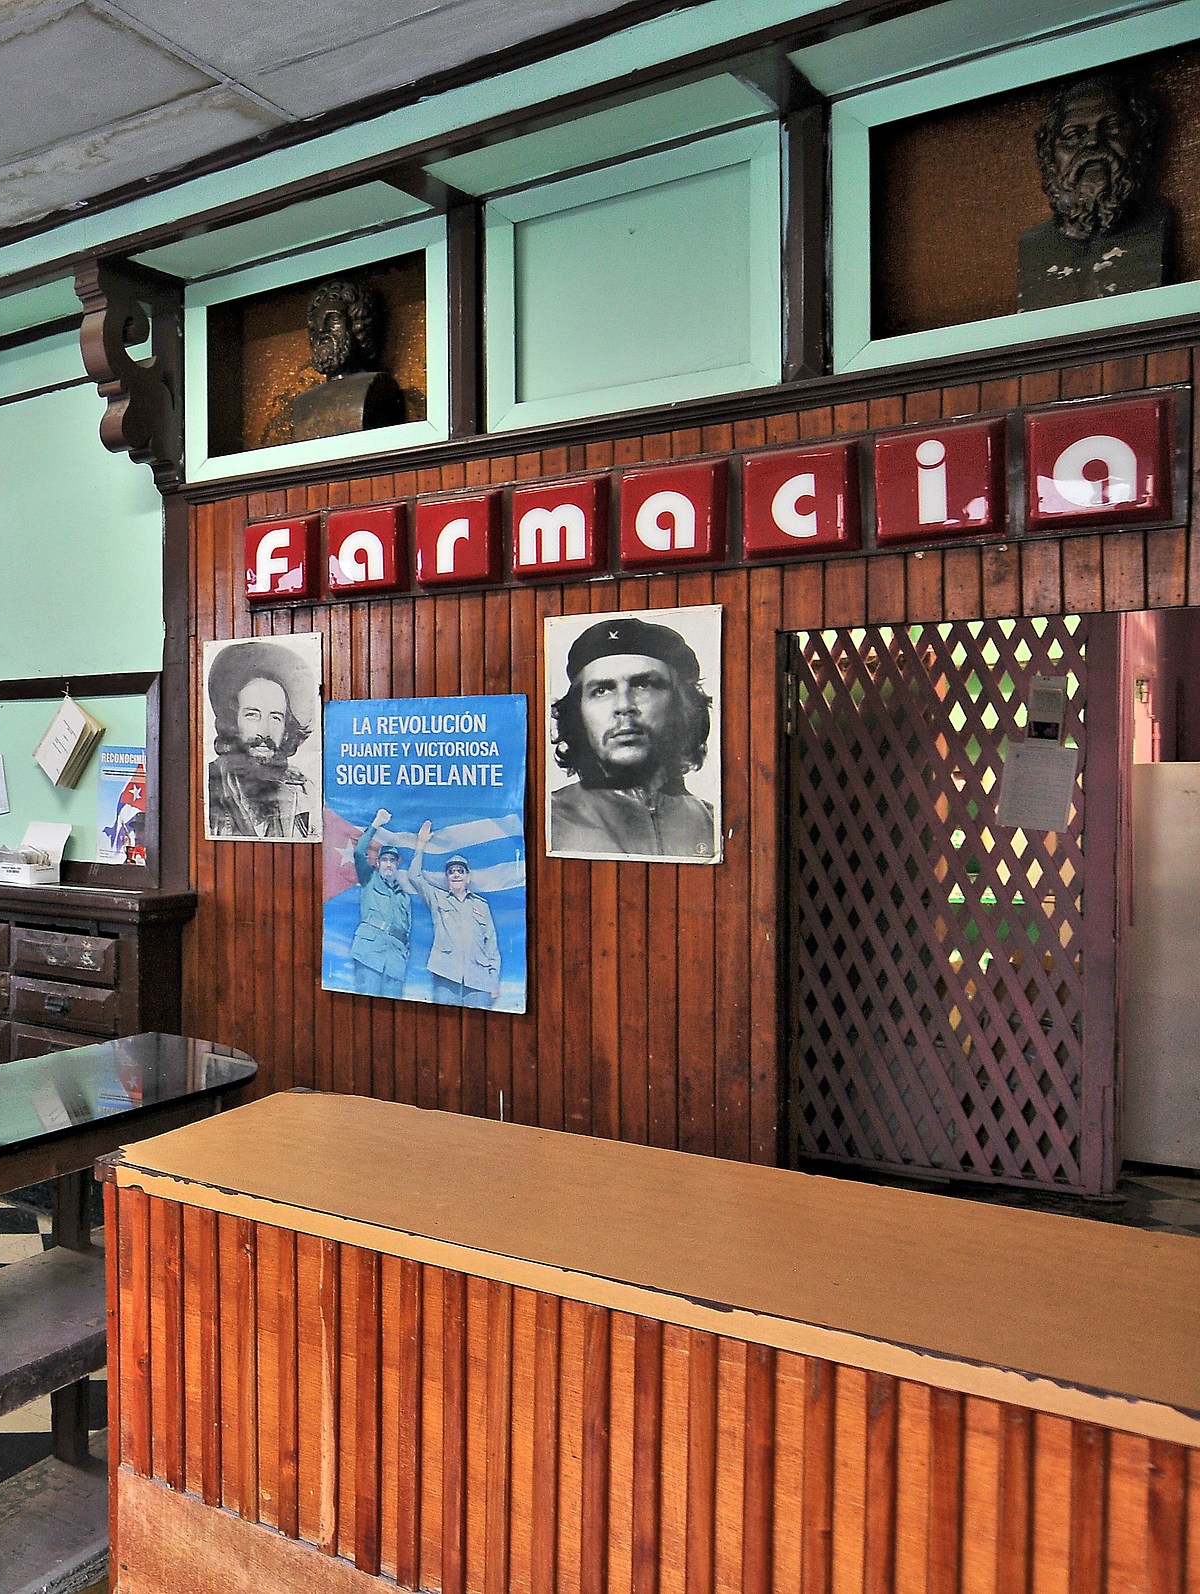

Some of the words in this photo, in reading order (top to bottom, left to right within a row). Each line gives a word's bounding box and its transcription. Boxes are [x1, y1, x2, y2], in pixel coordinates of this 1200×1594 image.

[252, 434, 1138, 593] farmacia
[352, 717, 372, 735] LA
[377, 711, 487, 735] REVOLUCIÓN
[340, 742, 399, 758] PUJANTE
[401, 742, 411, 758] Y
[415, 741, 500, 758] VICTORIOSA
[336, 764, 392, 786] SIGUE
[396, 764, 504, 787] ADELANTE
